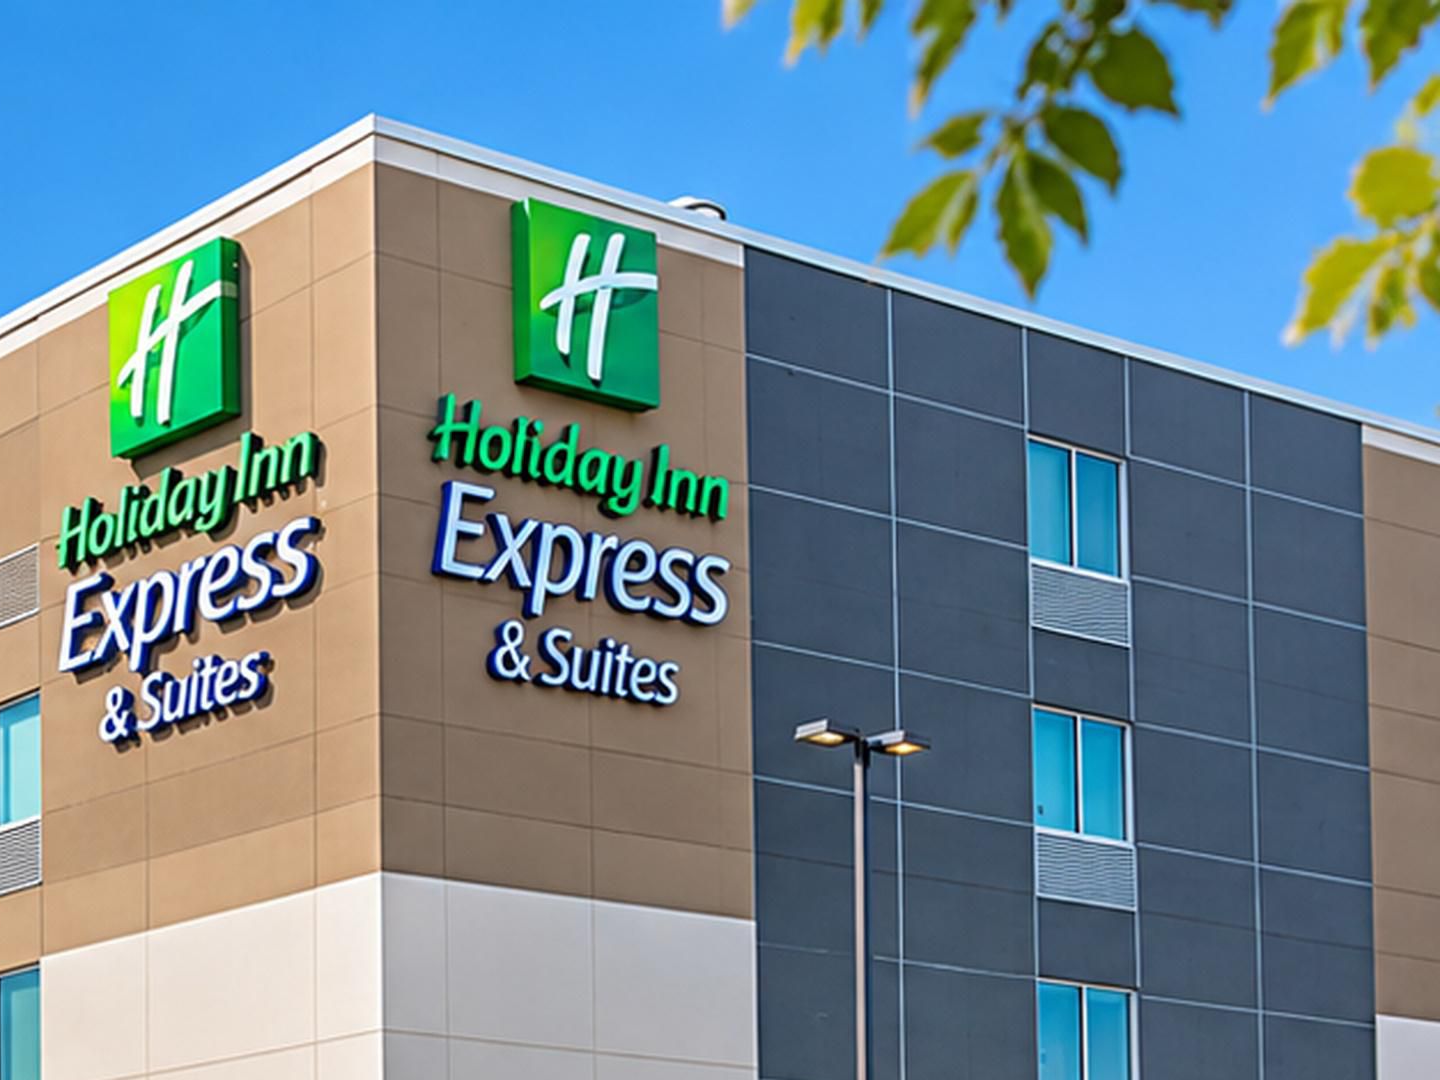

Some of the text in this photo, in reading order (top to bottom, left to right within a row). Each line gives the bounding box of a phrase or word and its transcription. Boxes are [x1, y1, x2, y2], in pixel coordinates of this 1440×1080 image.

[57, 431, 315, 568] Holiday Inn
[431, 392, 729, 519] Holiday Inn
[58, 516, 316, 673] Express
[436, 480, 731, 625] Express
[98, 652, 265, 743] & Suites
[491, 619, 680, 705] & Suites
